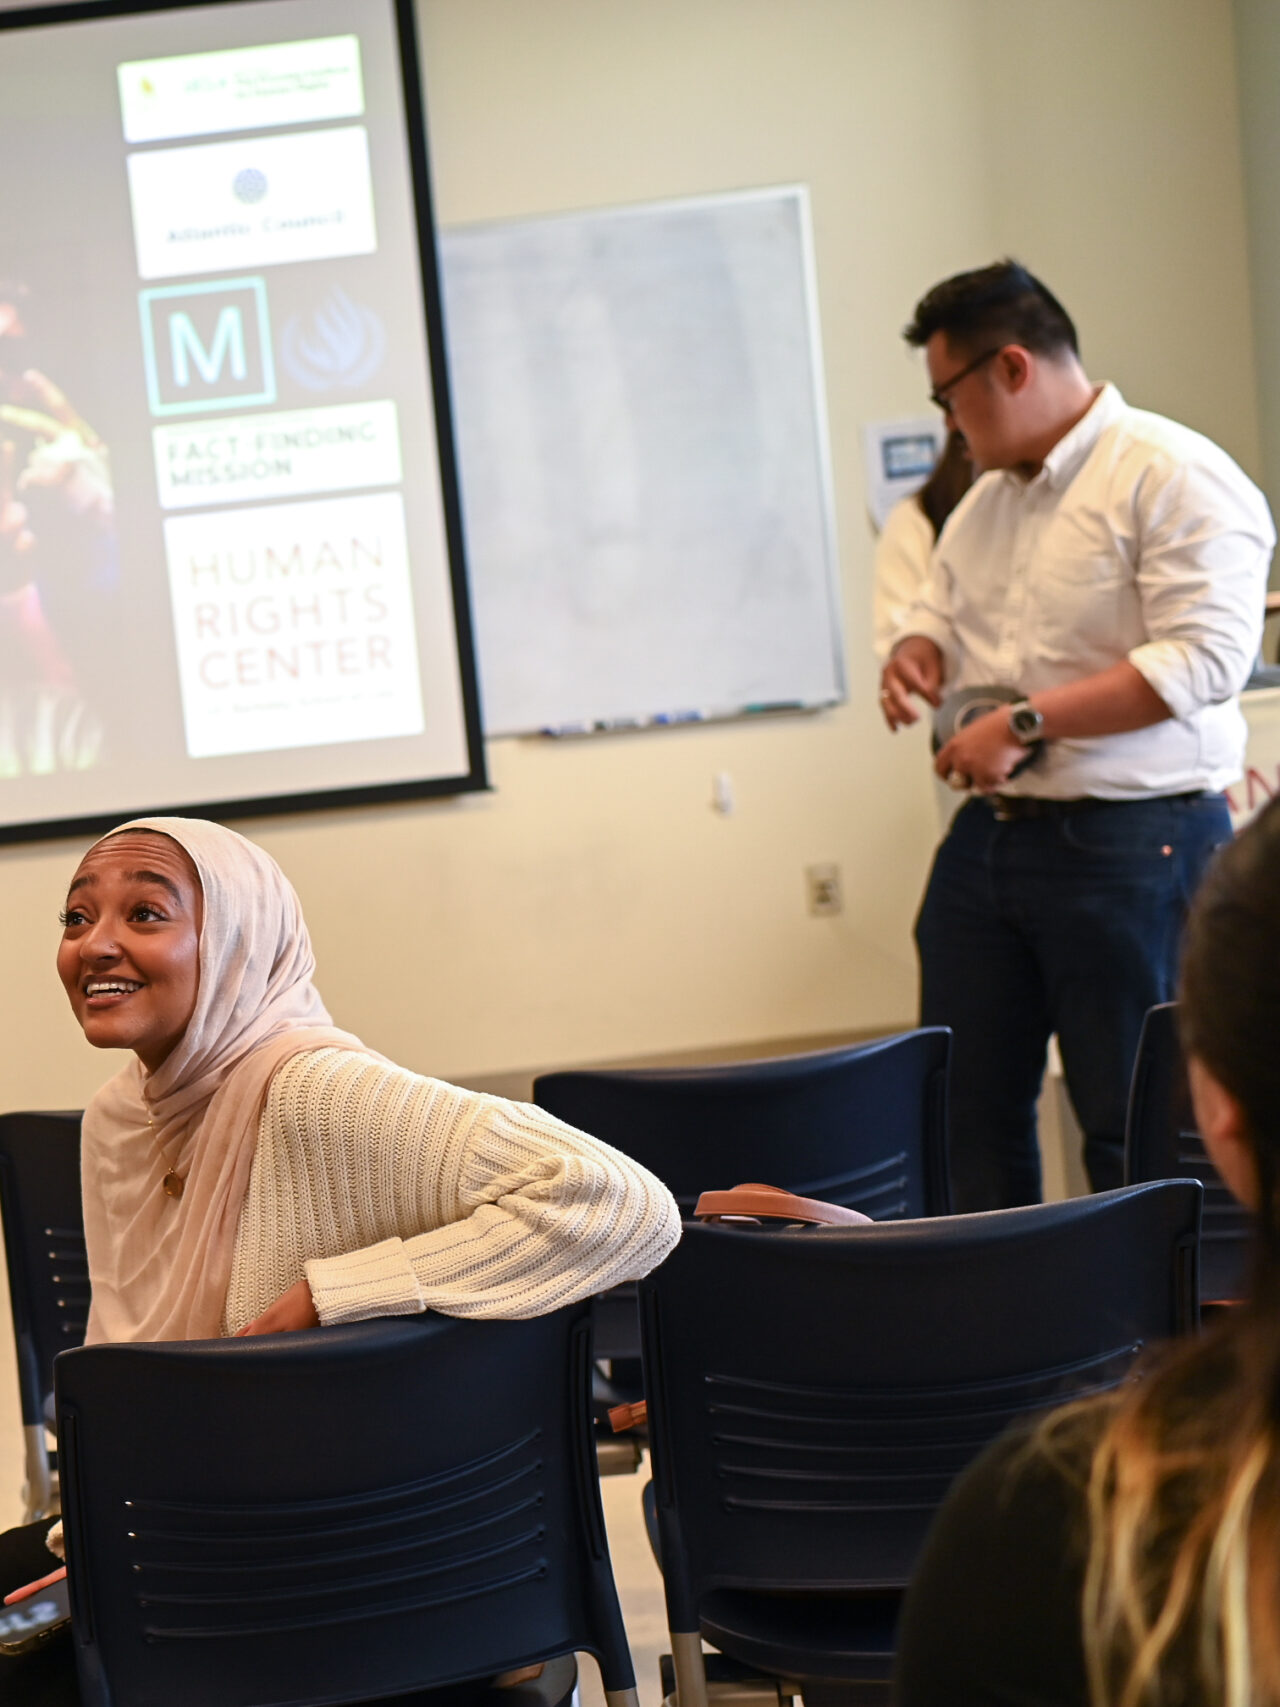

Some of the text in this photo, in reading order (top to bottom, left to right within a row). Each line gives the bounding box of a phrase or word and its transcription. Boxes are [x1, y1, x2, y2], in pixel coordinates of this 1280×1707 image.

[169, 305, 247, 387] M
[170, 457, 292, 487] MISSION
[189, 536, 384, 586] HUMAN
[194, 583, 388, 639] RIGHTS
[198, 634, 393, 690] CENTER
